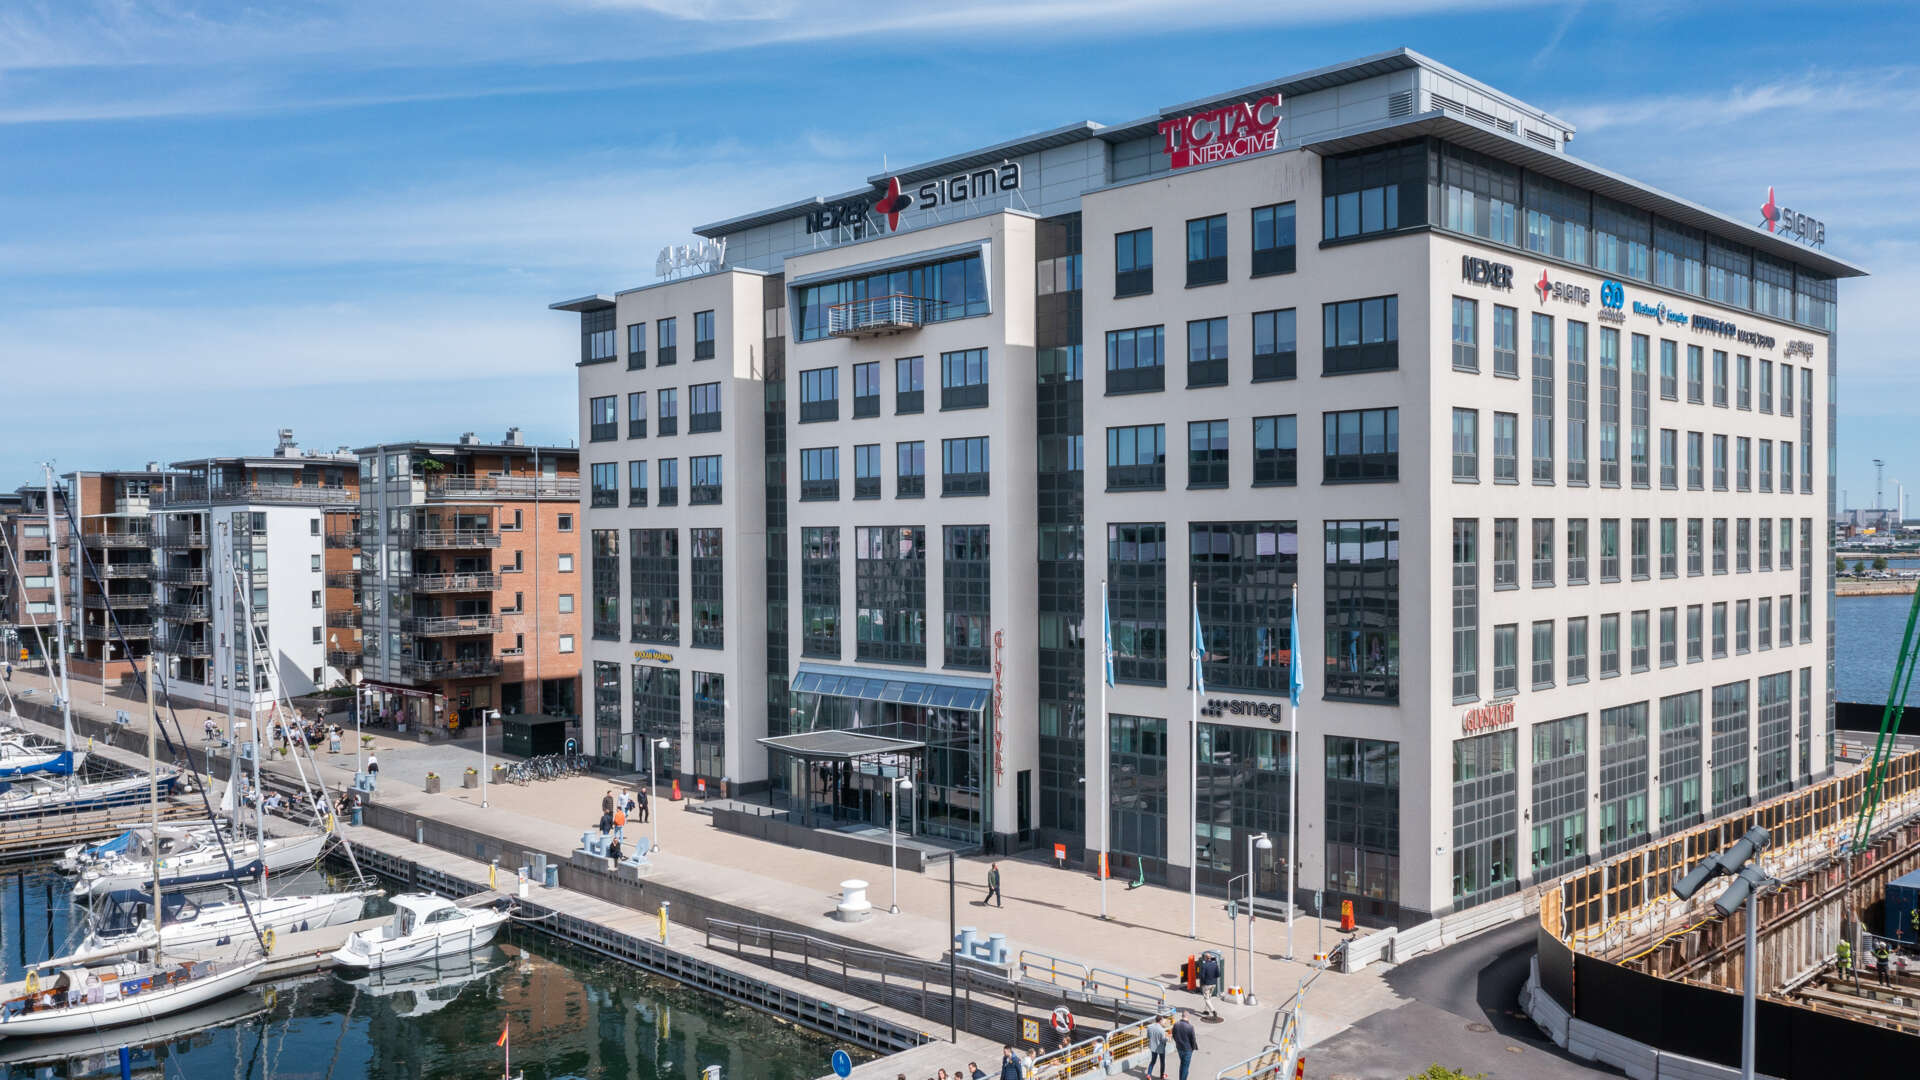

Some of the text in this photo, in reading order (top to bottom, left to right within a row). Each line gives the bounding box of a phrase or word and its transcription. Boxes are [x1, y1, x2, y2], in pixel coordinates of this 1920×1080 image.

[1158, 93, 1282, 154] TICTAC
[1188, 129, 1279, 166] INTERACTIVE
[1462, 254, 1514, 289] NEXER
[1230, 699, 1281, 723] smeg
